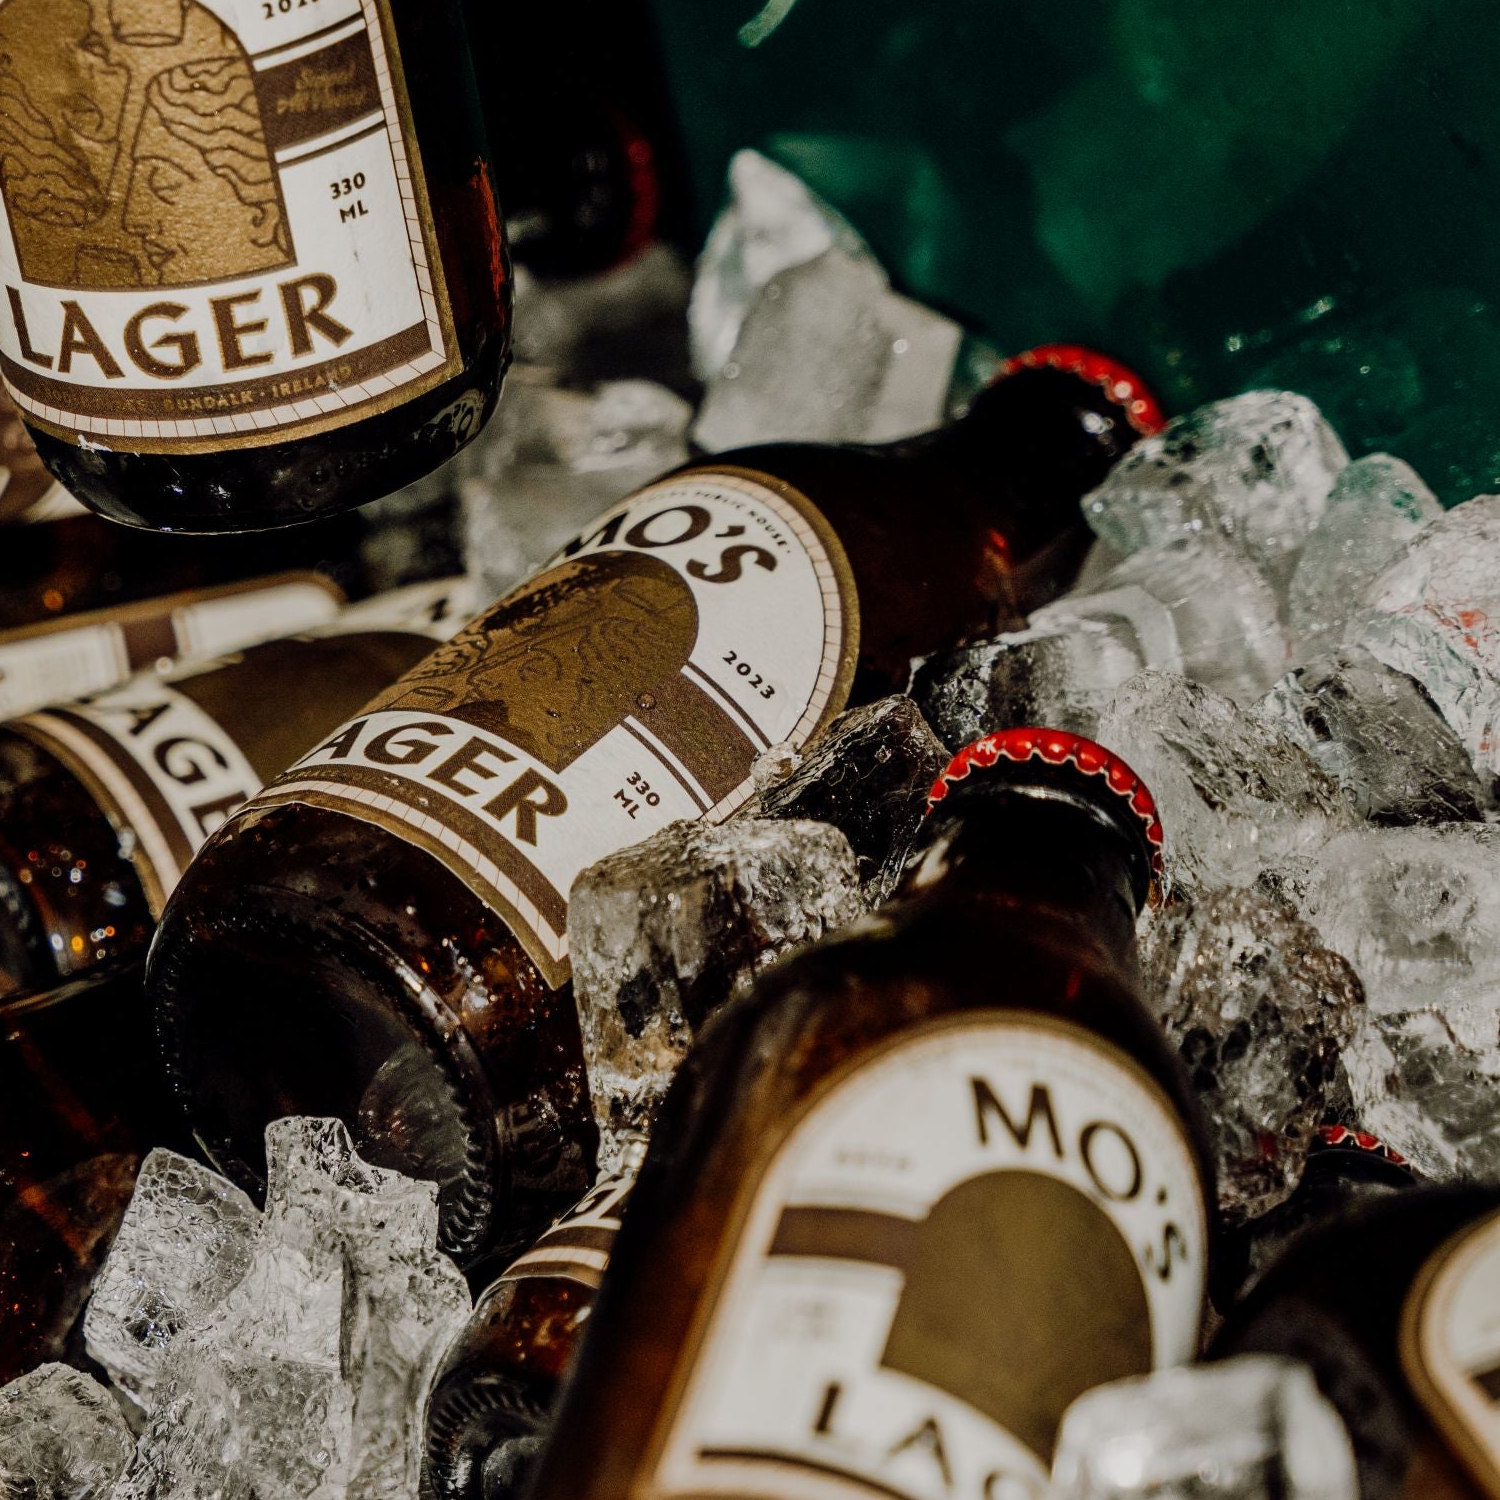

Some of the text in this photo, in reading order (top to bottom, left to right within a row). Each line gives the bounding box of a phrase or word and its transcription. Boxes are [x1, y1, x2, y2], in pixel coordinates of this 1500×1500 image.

[330, 171, 366, 200] 330
[339, 200, 369, 224] ML
[4, 271, 356, 380] LAGER
[271, 363, 353, 399] IRELAND
[749, 510, 789, 547] HOUSE
[722, 650, 776, 700] 2023
[127, 703, 251, 838] AGE
[295, 718, 568, 848] AGER
[626, 771, 661, 807] 330
[613, 788, 641, 820] ML
[968, 1074, 1190, 1285] MO'S
